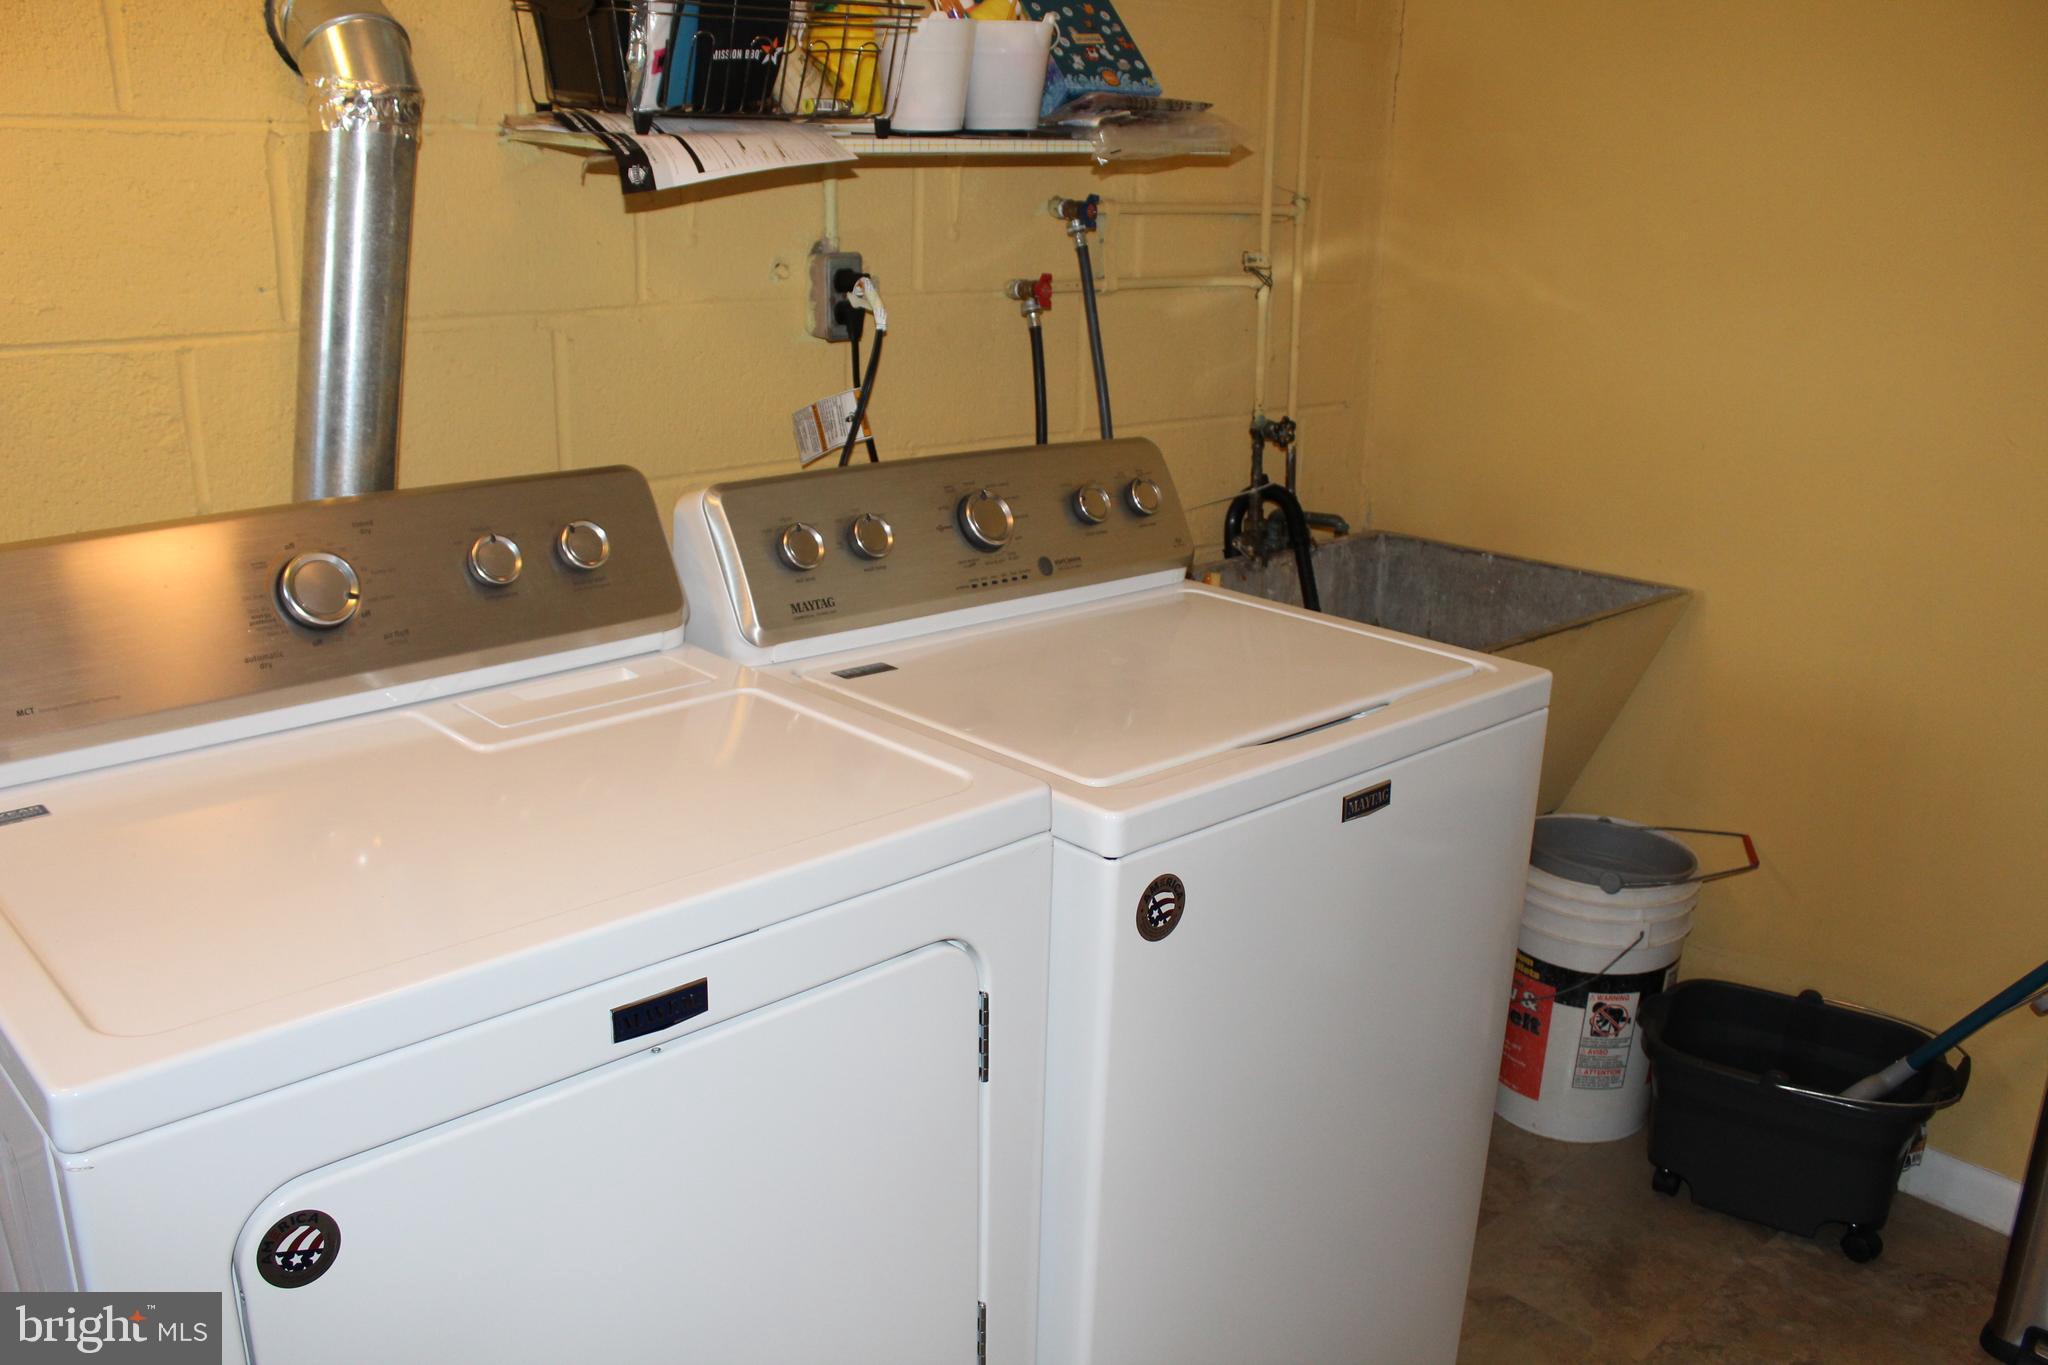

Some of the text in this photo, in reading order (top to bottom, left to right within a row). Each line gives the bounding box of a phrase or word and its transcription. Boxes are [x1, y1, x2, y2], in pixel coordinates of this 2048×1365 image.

[790, 596, 837, 615] MAYTAG
[16, 706, 35, 718] MCT
[1348, 789, 1389, 814] MAYTAG
